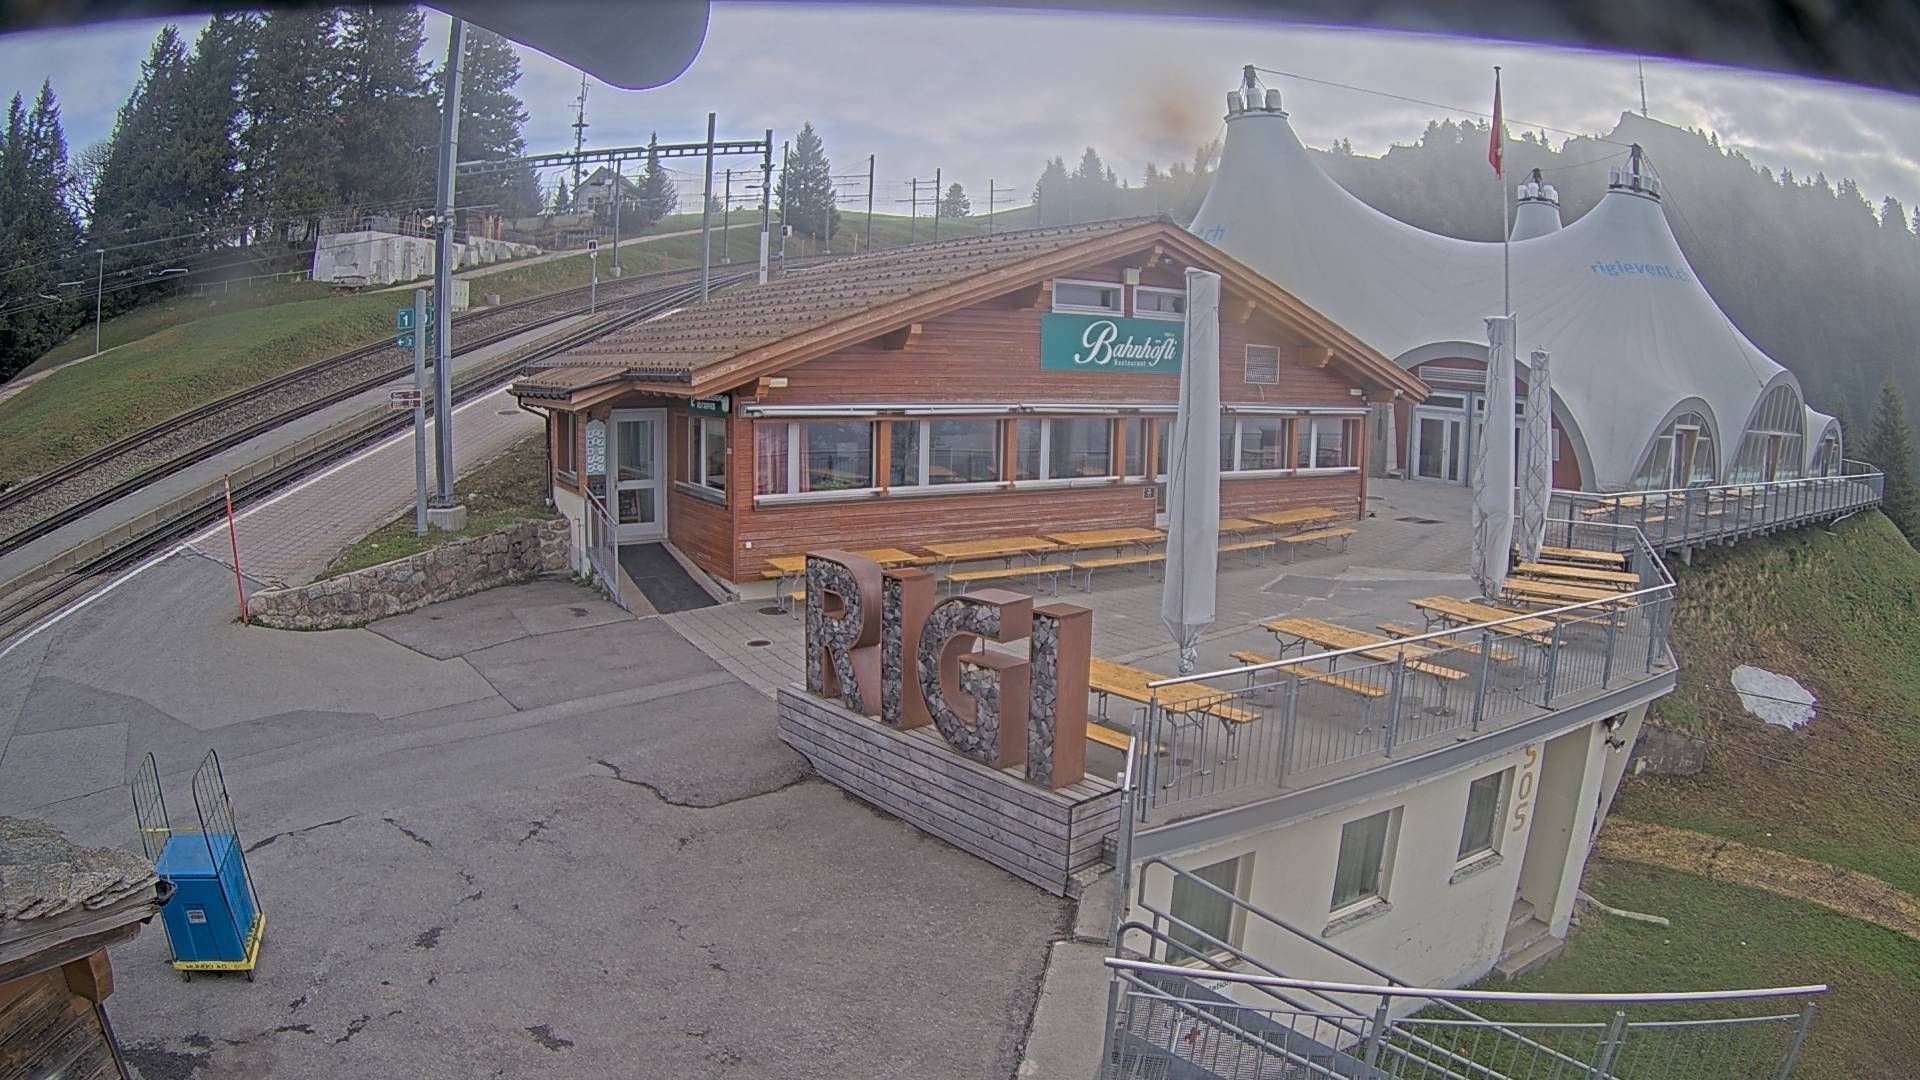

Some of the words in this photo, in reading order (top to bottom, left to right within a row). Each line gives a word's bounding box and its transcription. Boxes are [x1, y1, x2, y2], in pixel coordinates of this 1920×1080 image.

[402, 314, 409, 327] 1
[1074, 320, 1178, 367] Bahnhöfli
[805, 550, 1093, 789] RIGI
[1513, 743, 1537, 832] SOS
